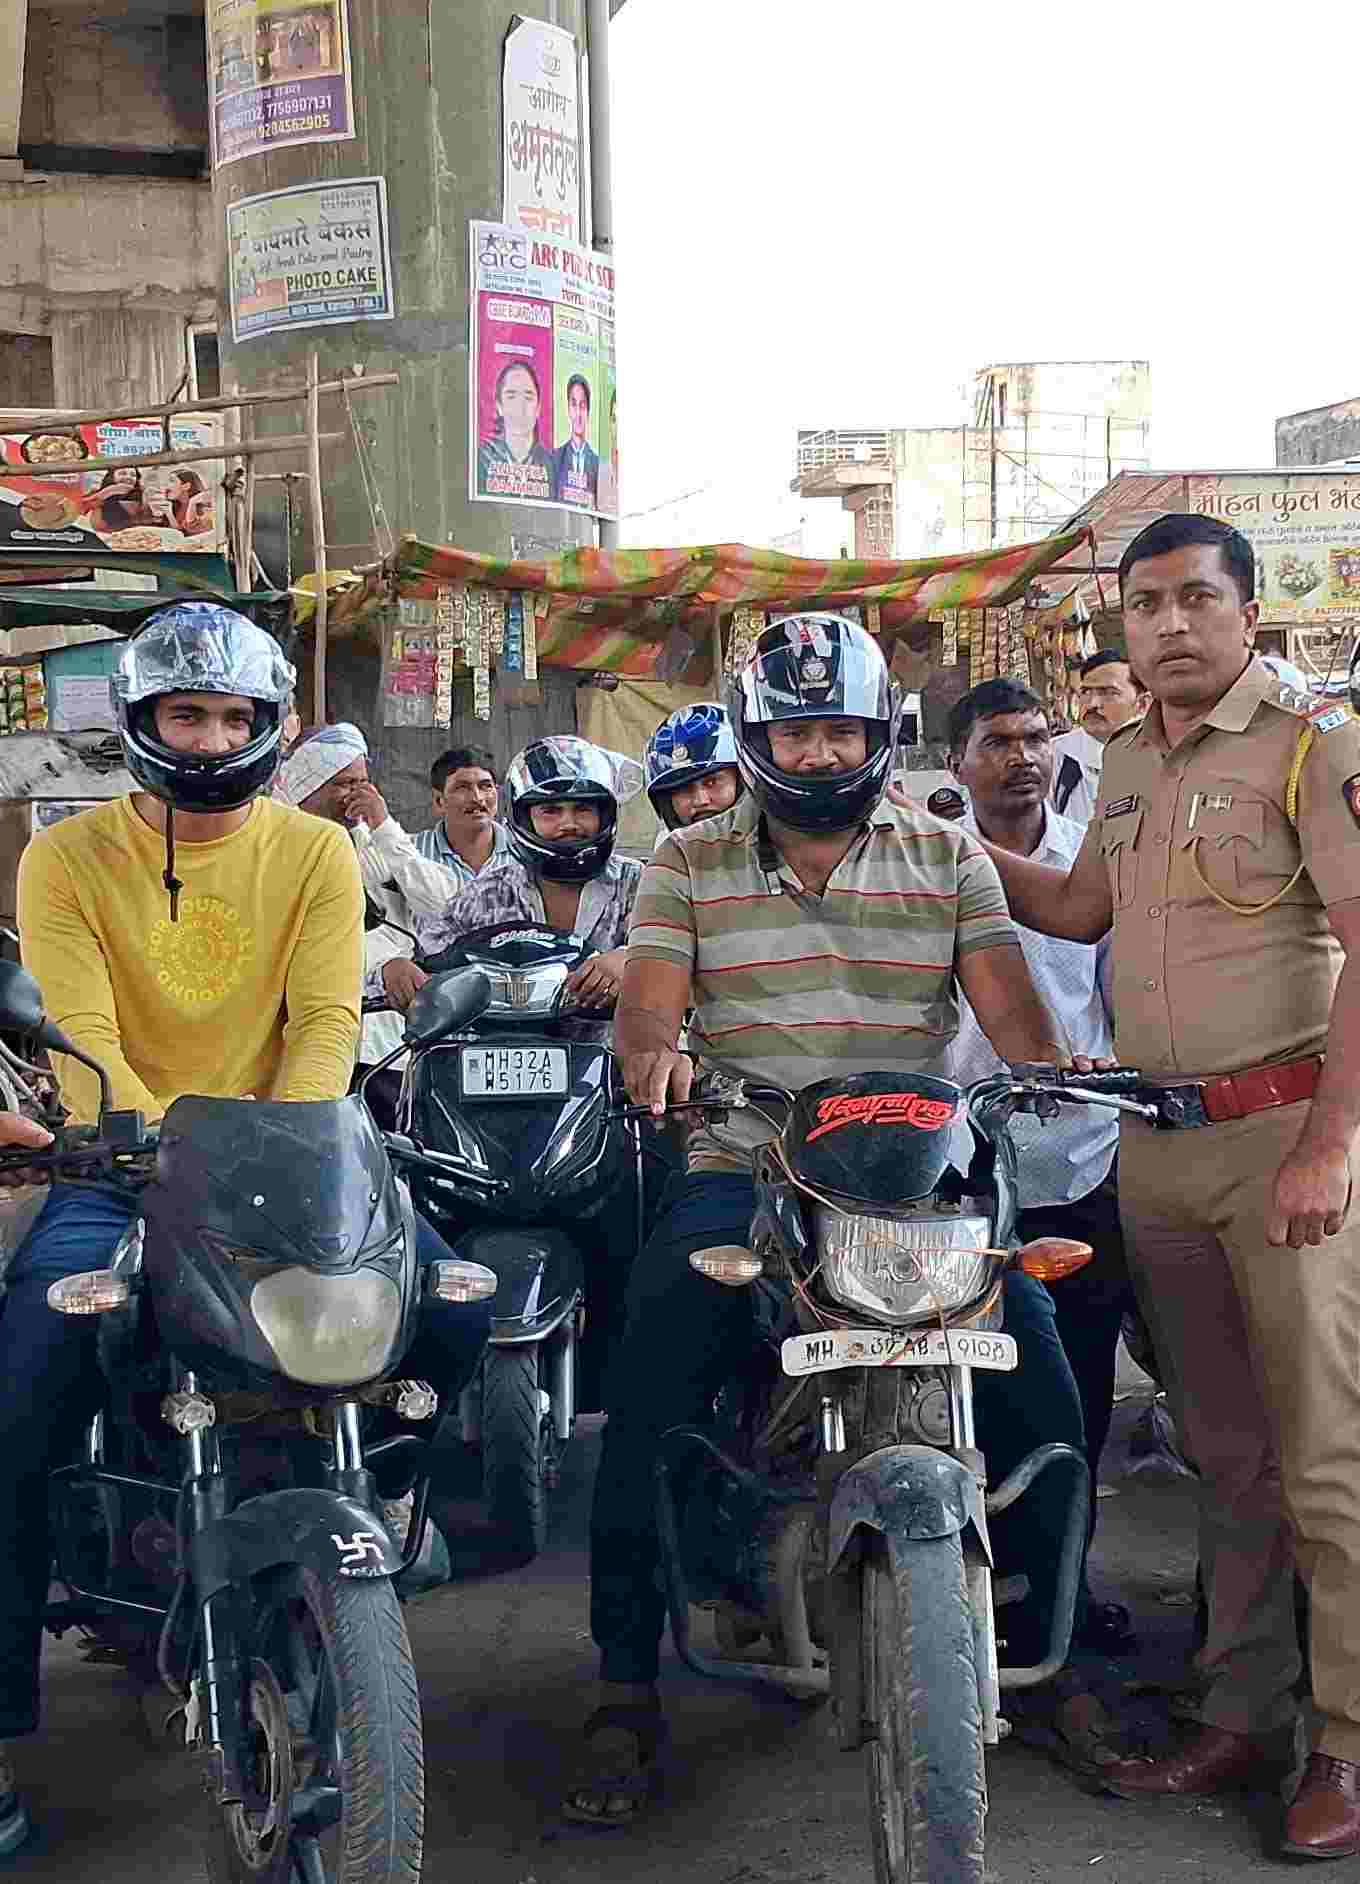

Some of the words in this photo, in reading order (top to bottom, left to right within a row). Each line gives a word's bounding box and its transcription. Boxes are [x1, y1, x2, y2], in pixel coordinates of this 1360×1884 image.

[287, 271, 332, 290] PHOTO
[336, 266, 377, 284] CAKE
[1194, 480, 1261, 516] मोहन
[1272, 489, 1320, 522] फुल
